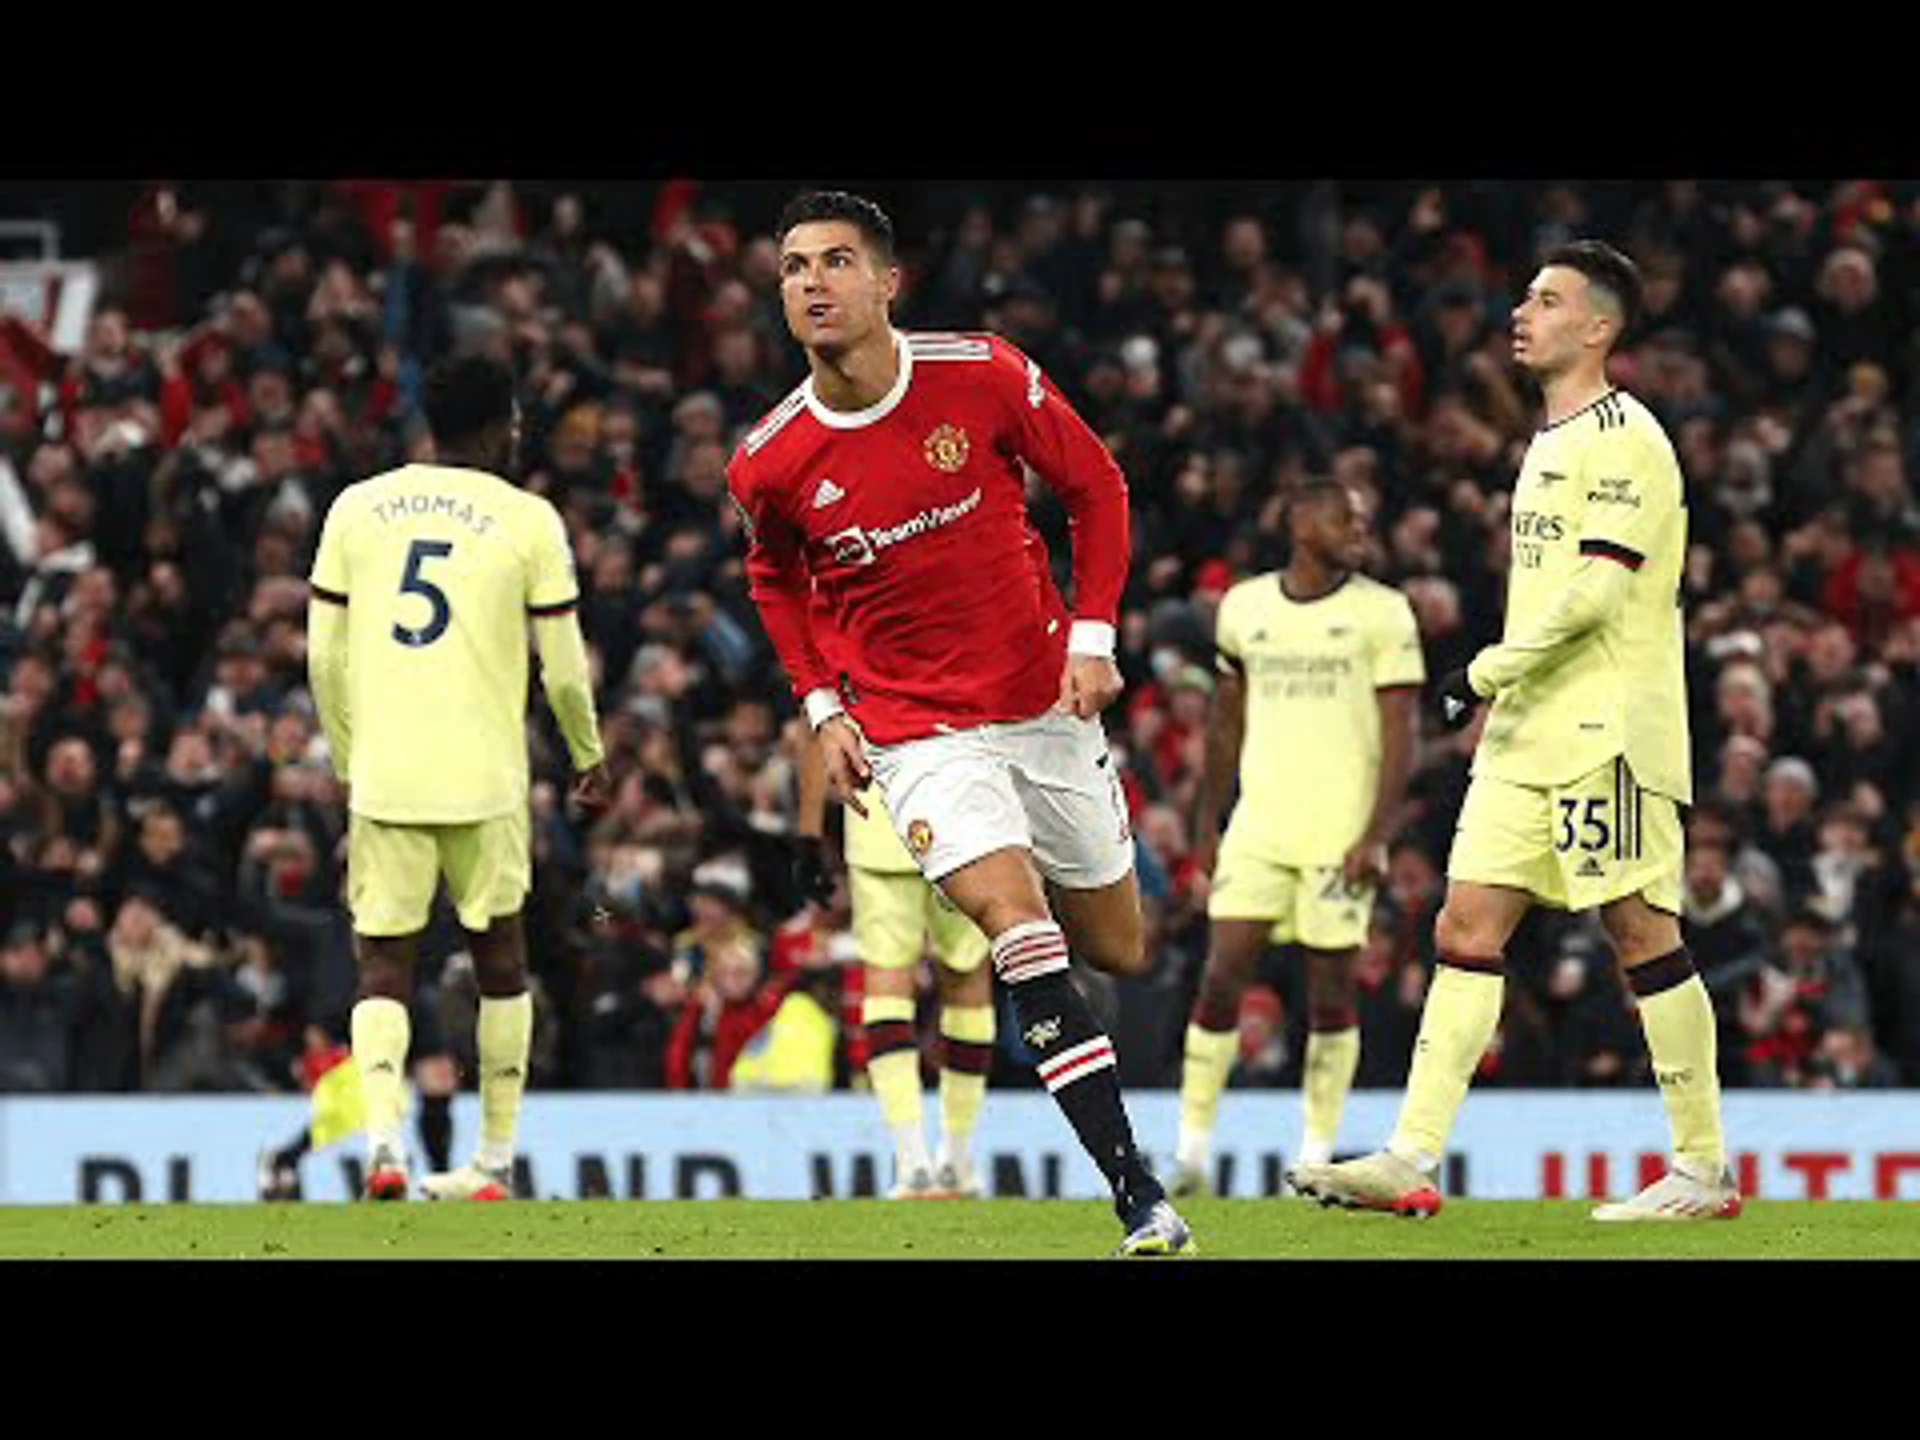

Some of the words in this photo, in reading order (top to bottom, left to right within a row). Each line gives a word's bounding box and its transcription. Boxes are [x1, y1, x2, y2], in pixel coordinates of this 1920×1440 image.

[372, 495, 496, 535] THOMAS
[867, 486, 981, 548] TeamViewer
[391, 539, 453, 648] 5
[1555, 798, 1610, 852] 35
